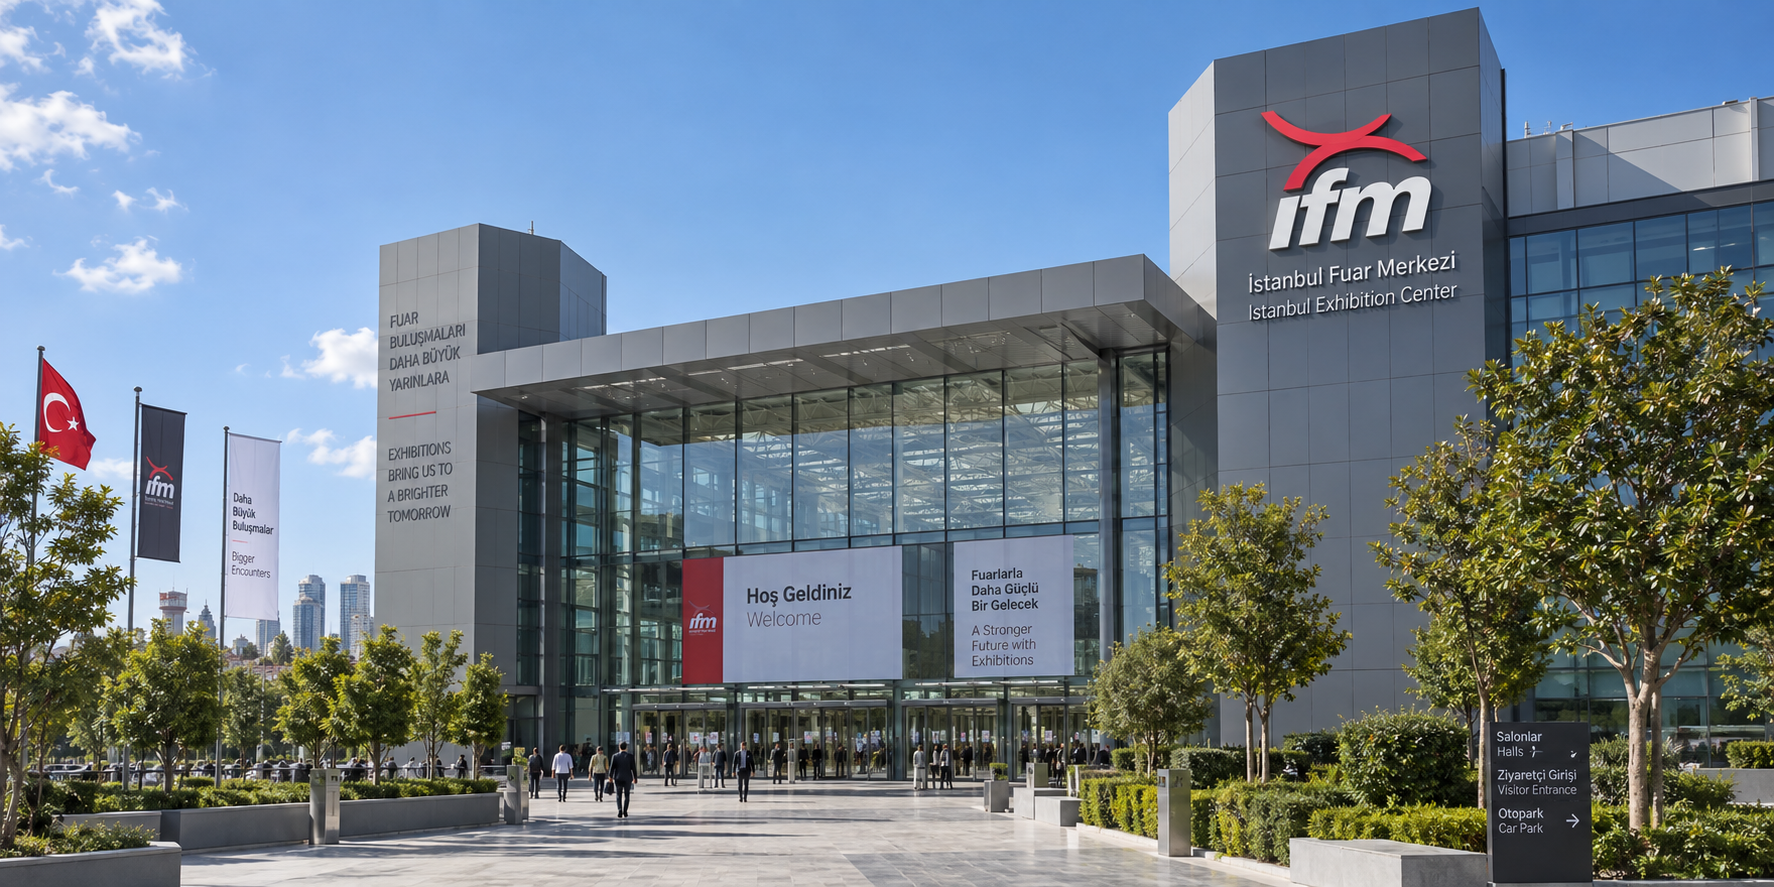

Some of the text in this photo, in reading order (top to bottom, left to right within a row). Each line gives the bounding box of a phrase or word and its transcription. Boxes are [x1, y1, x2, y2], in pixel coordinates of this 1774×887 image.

[1269, 167, 1432, 250] ifm
[1249, 251, 1456, 293] İstanbul Fuar Merkezi
[1249, 283, 1457, 320] Istanbul Exhibition Center
[390, 311, 418, 328] FUAR
[390, 323, 466, 349] BULUŞMALARI
[389, 345, 461, 370] DAHA BÜYÜK
[389, 370, 450, 392] YARINLARA
[388, 441, 451, 461] EXHIBITIONS
[388, 462, 453, 482] BRING US TO
[145, 475, 175, 499] ifm
[387, 484, 449, 502] A BRIGHTER
[233, 493, 252, 504] Daha
[233, 506, 256, 519] Büyük
[387, 505, 451, 523] TOMORROW
[233, 520, 274, 535] Buluşmalar
[232, 551, 255, 565] Bigger
[232, 565, 270, 578] Encounters
[972, 568, 1023, 580] Fuarlarla
[747, 583, 851, 607] Hoş Geldiniz
[972, 582, 1039, 596] Daha Güçlü
[972, 598, 1039, 611] Bir Gelecek
[689, 612, 717, 629] ifm
[747, 611, 821, 627] Welcome
[972, 625, 1032, 637] A Stronger
[972, 639, 1036, 651] Future with
[972, 654, 1034, 666] Exhibitions
[1497, 731, 1542, 742] Salonlar
[1498, 746, 1524, 757] Halls
[1498, 769, 1577, 782] Ziyaretçi Girişi
[1498, 784, 1577, 795] Visitor Entrance
[1498, 807, 1544, 821] Otopark
[1499, 823, 1543, 834] Car Park
